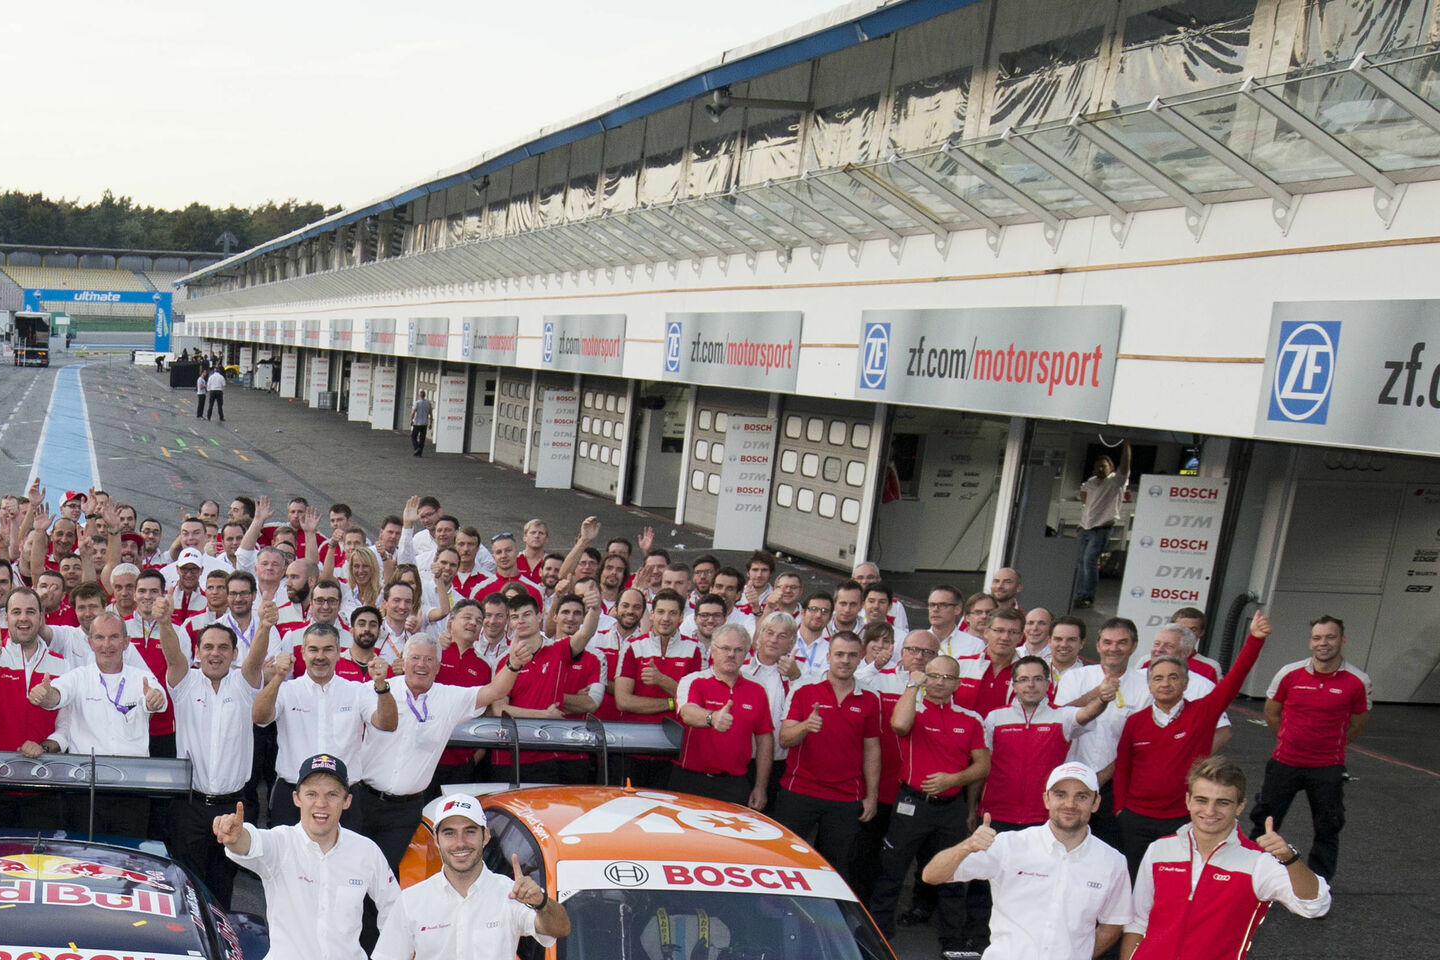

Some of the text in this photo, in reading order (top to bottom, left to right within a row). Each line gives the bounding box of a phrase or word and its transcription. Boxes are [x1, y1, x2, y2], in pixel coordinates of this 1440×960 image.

[74, 291, 121, 302] ultimate
[691, 332, 793, 376] zf.com/motorsport
[906, 335, 1103, 397] zf.com/motorsport
[744, 423, 772, 432] BOSCH
[743, 441, 770, 450] DTM
[740, 455, 768, 463] BOSCH
[739, 473, 766, 481] DTM
[736, 487, 764, 495] BOSCH
[1169, 487, 1219, 499] BOSCH
[735, 504, 762, 512] DTM
[1164, 515, 1213, 529] DTM
[1160, 538, 1209, 551] BOSCH
[1155, 565, 1203, 580] DTM
[1151, 588, 1199, 601] BOSCH
[1146, 615, 1171, 627] DT
[662, 864, 812, 891] BOSCH
[43, 881, 175, 918] Bull
